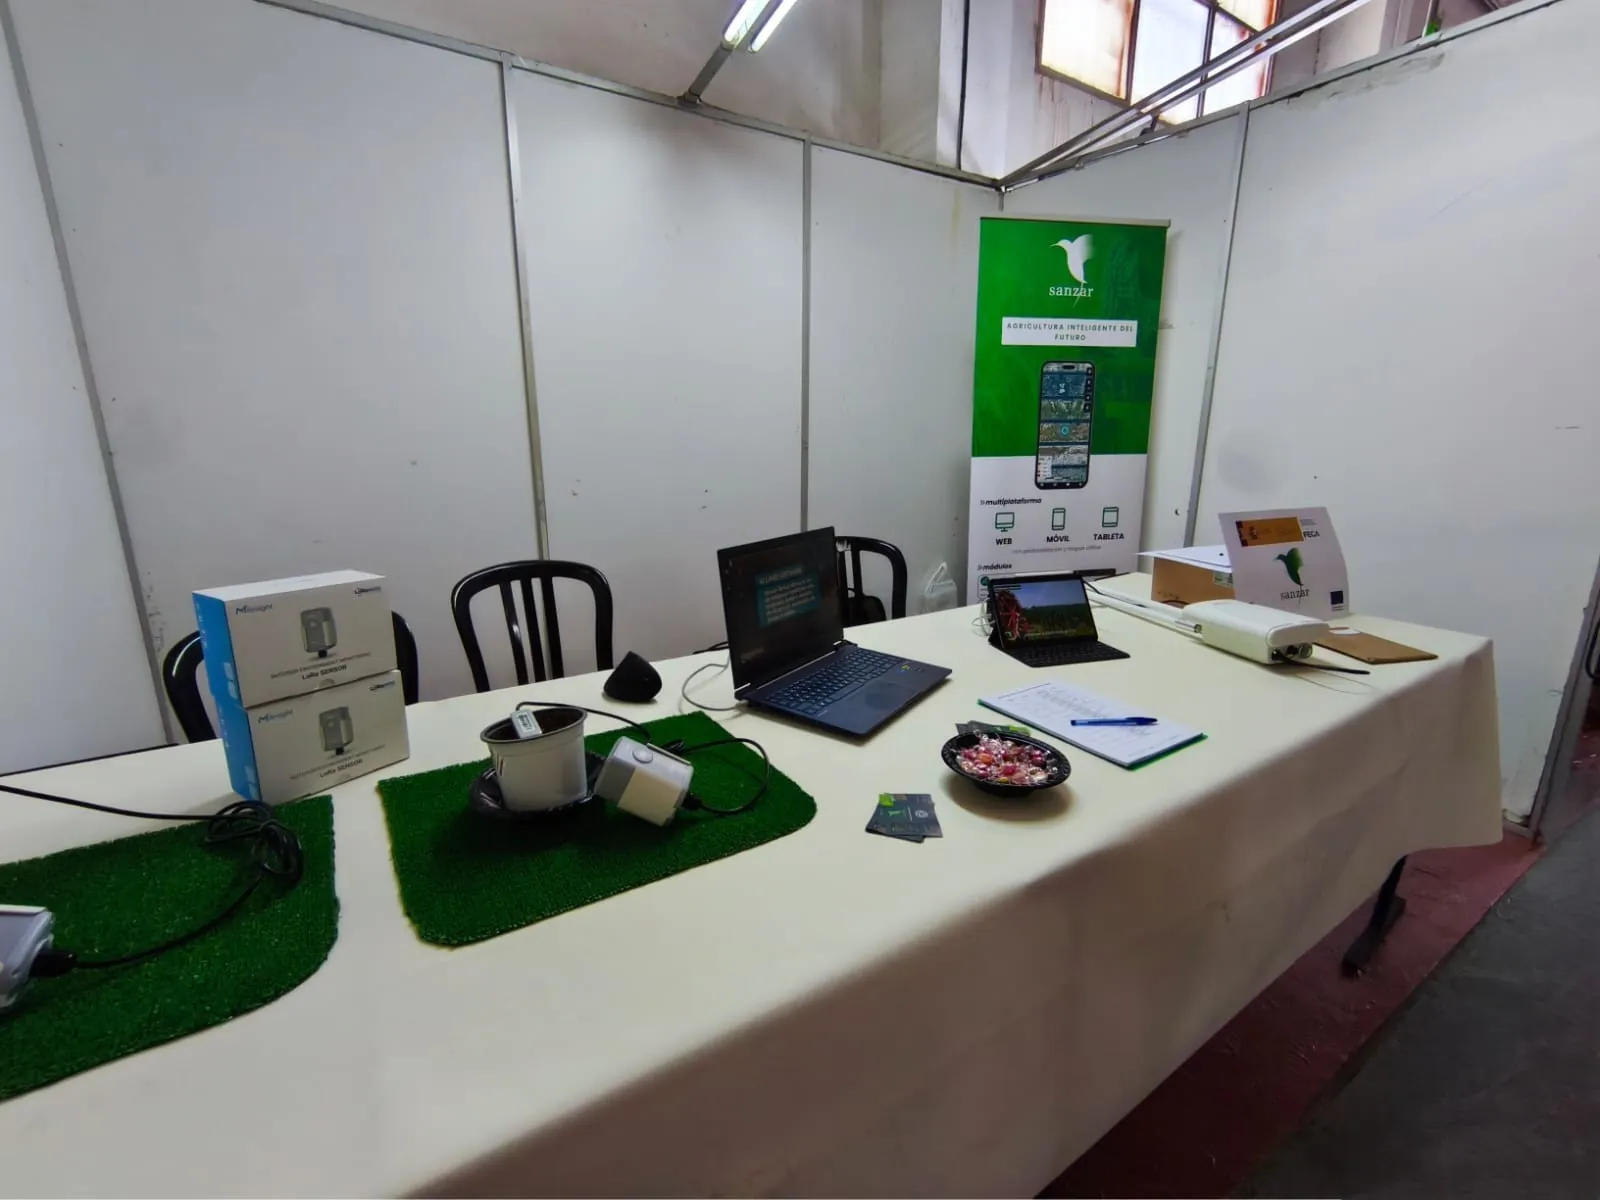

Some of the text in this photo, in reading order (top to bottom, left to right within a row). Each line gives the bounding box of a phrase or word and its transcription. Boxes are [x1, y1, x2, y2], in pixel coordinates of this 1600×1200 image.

[1048, 285, 1094, 297] sanzar
[1007, 322, 1064, 330] AGRICULTURA
[1067, 324, 1117, 332] INTELIGENTE
[1054, 333, 1086, 341] FUTURO
[995, 537, 1013, 545] WEB
[1046, 534, 1070, 543] MÓVIL
[1093, 533, 1125, 541] TABLETA
[1280, 588, 1310, 600] sanzar
